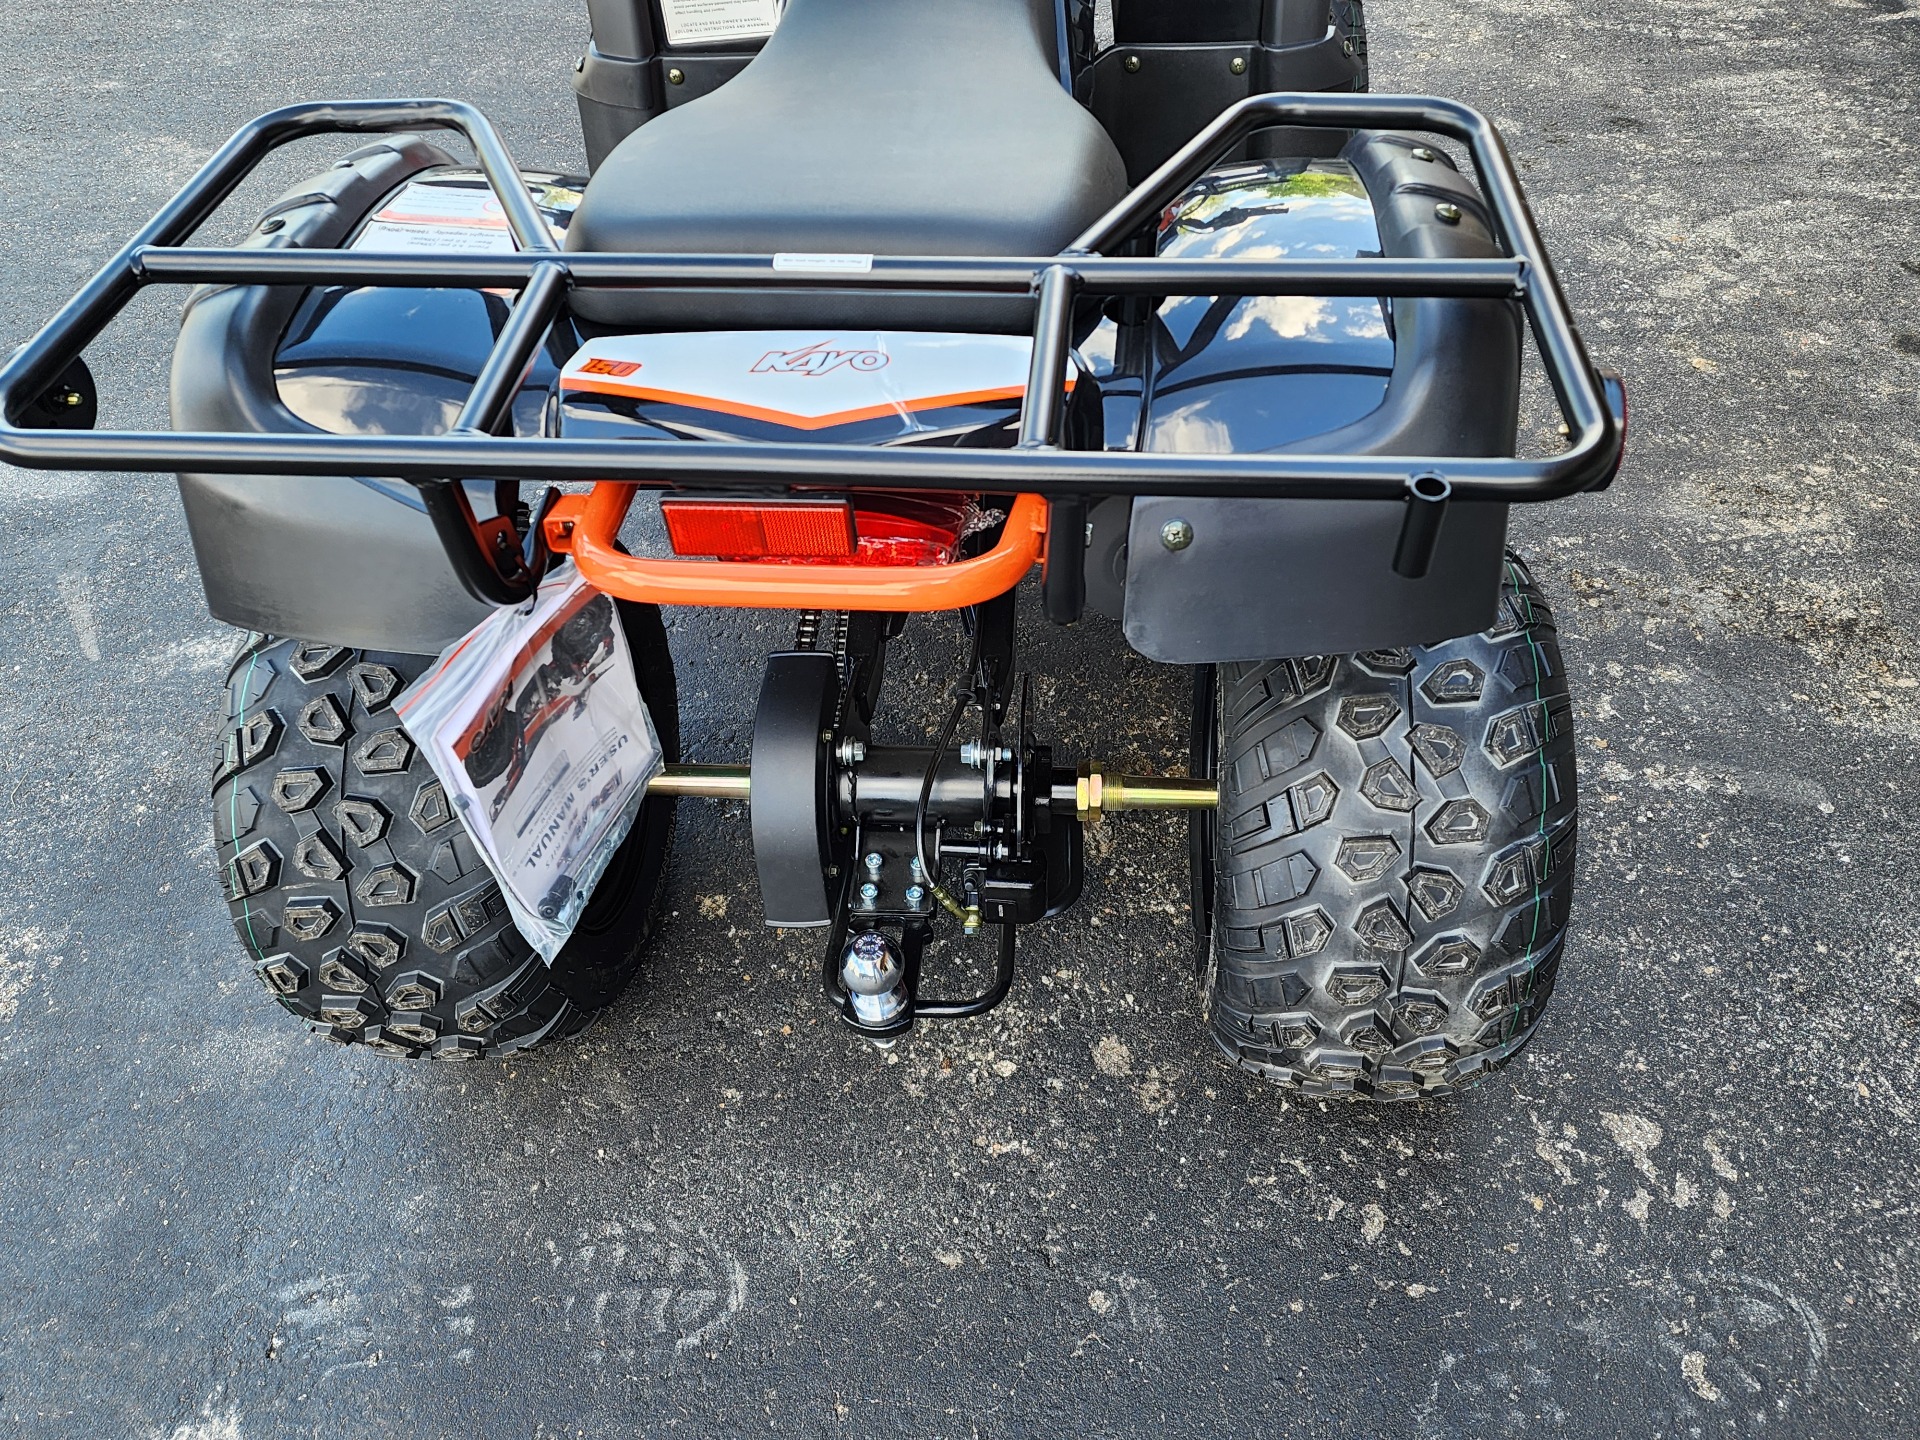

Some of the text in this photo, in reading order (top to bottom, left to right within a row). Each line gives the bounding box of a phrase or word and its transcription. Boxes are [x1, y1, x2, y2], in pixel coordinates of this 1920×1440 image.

[576, 339, 890, 377] 150 KAYO
[575, 735, 630, 792] USER'S
[523, 791, 575, 869] MANUAL
